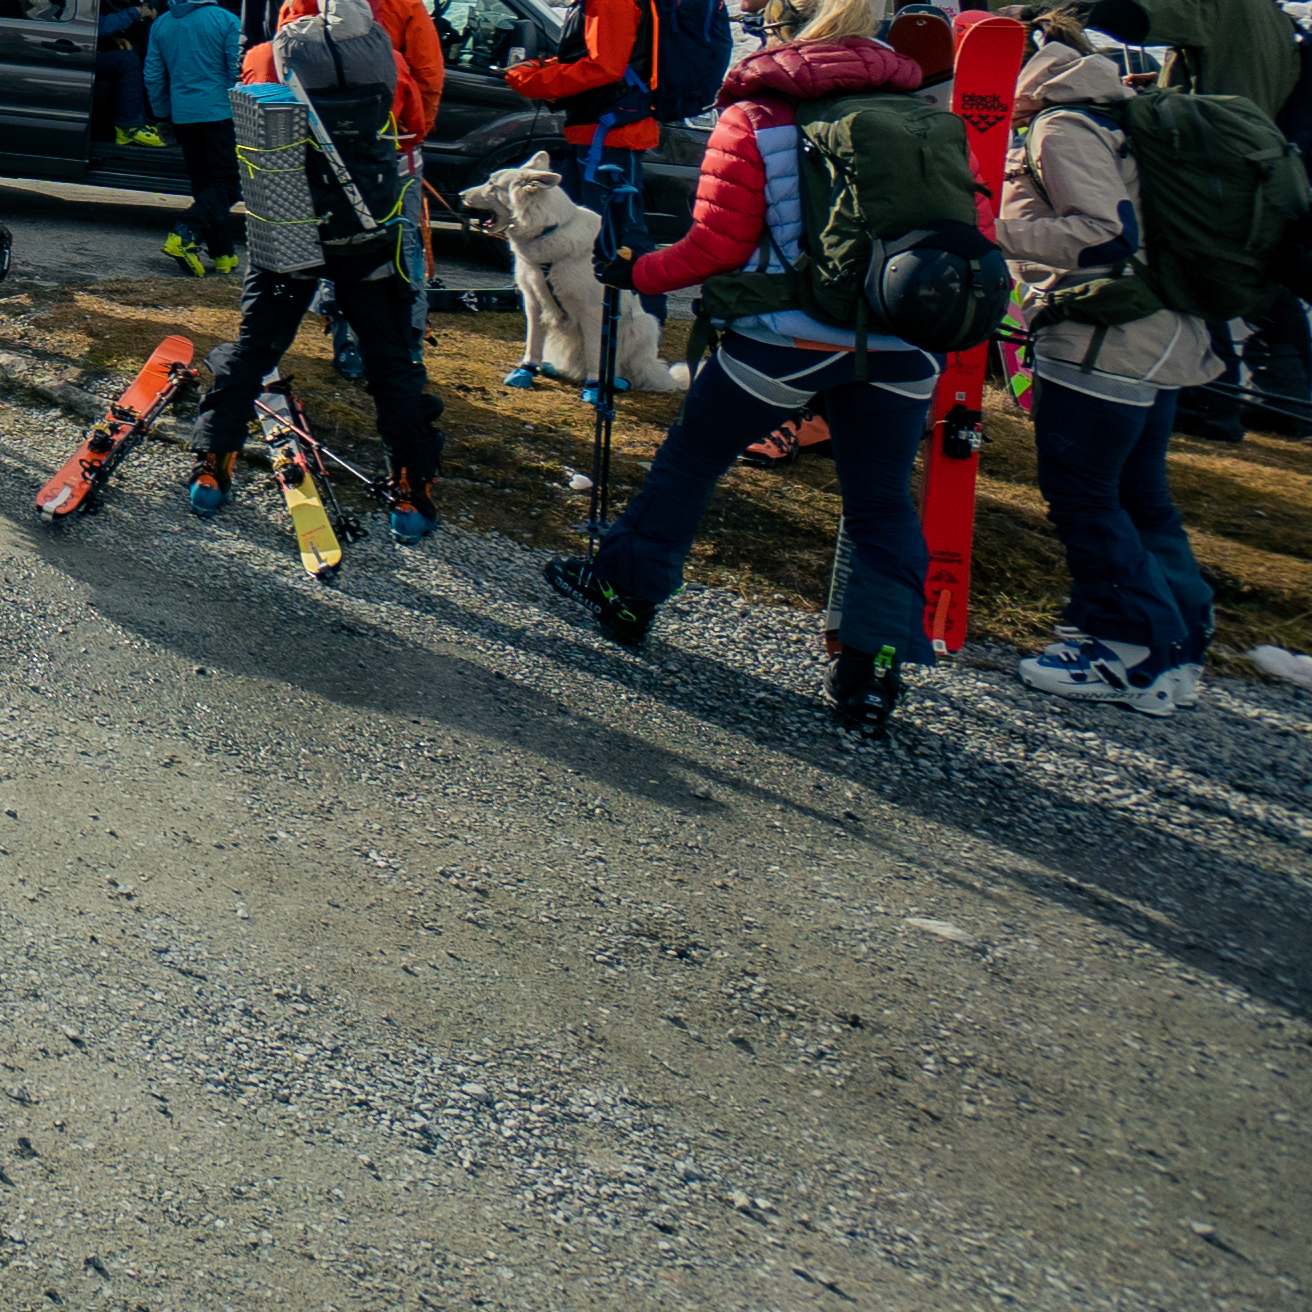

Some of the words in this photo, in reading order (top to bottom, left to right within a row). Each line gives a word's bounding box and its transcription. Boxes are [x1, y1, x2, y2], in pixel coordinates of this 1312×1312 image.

[962, 92, 1002, 104] black
[961, 101, 1008, 112] crows
[1068, 691, 1148, 700] DYNAFIT
